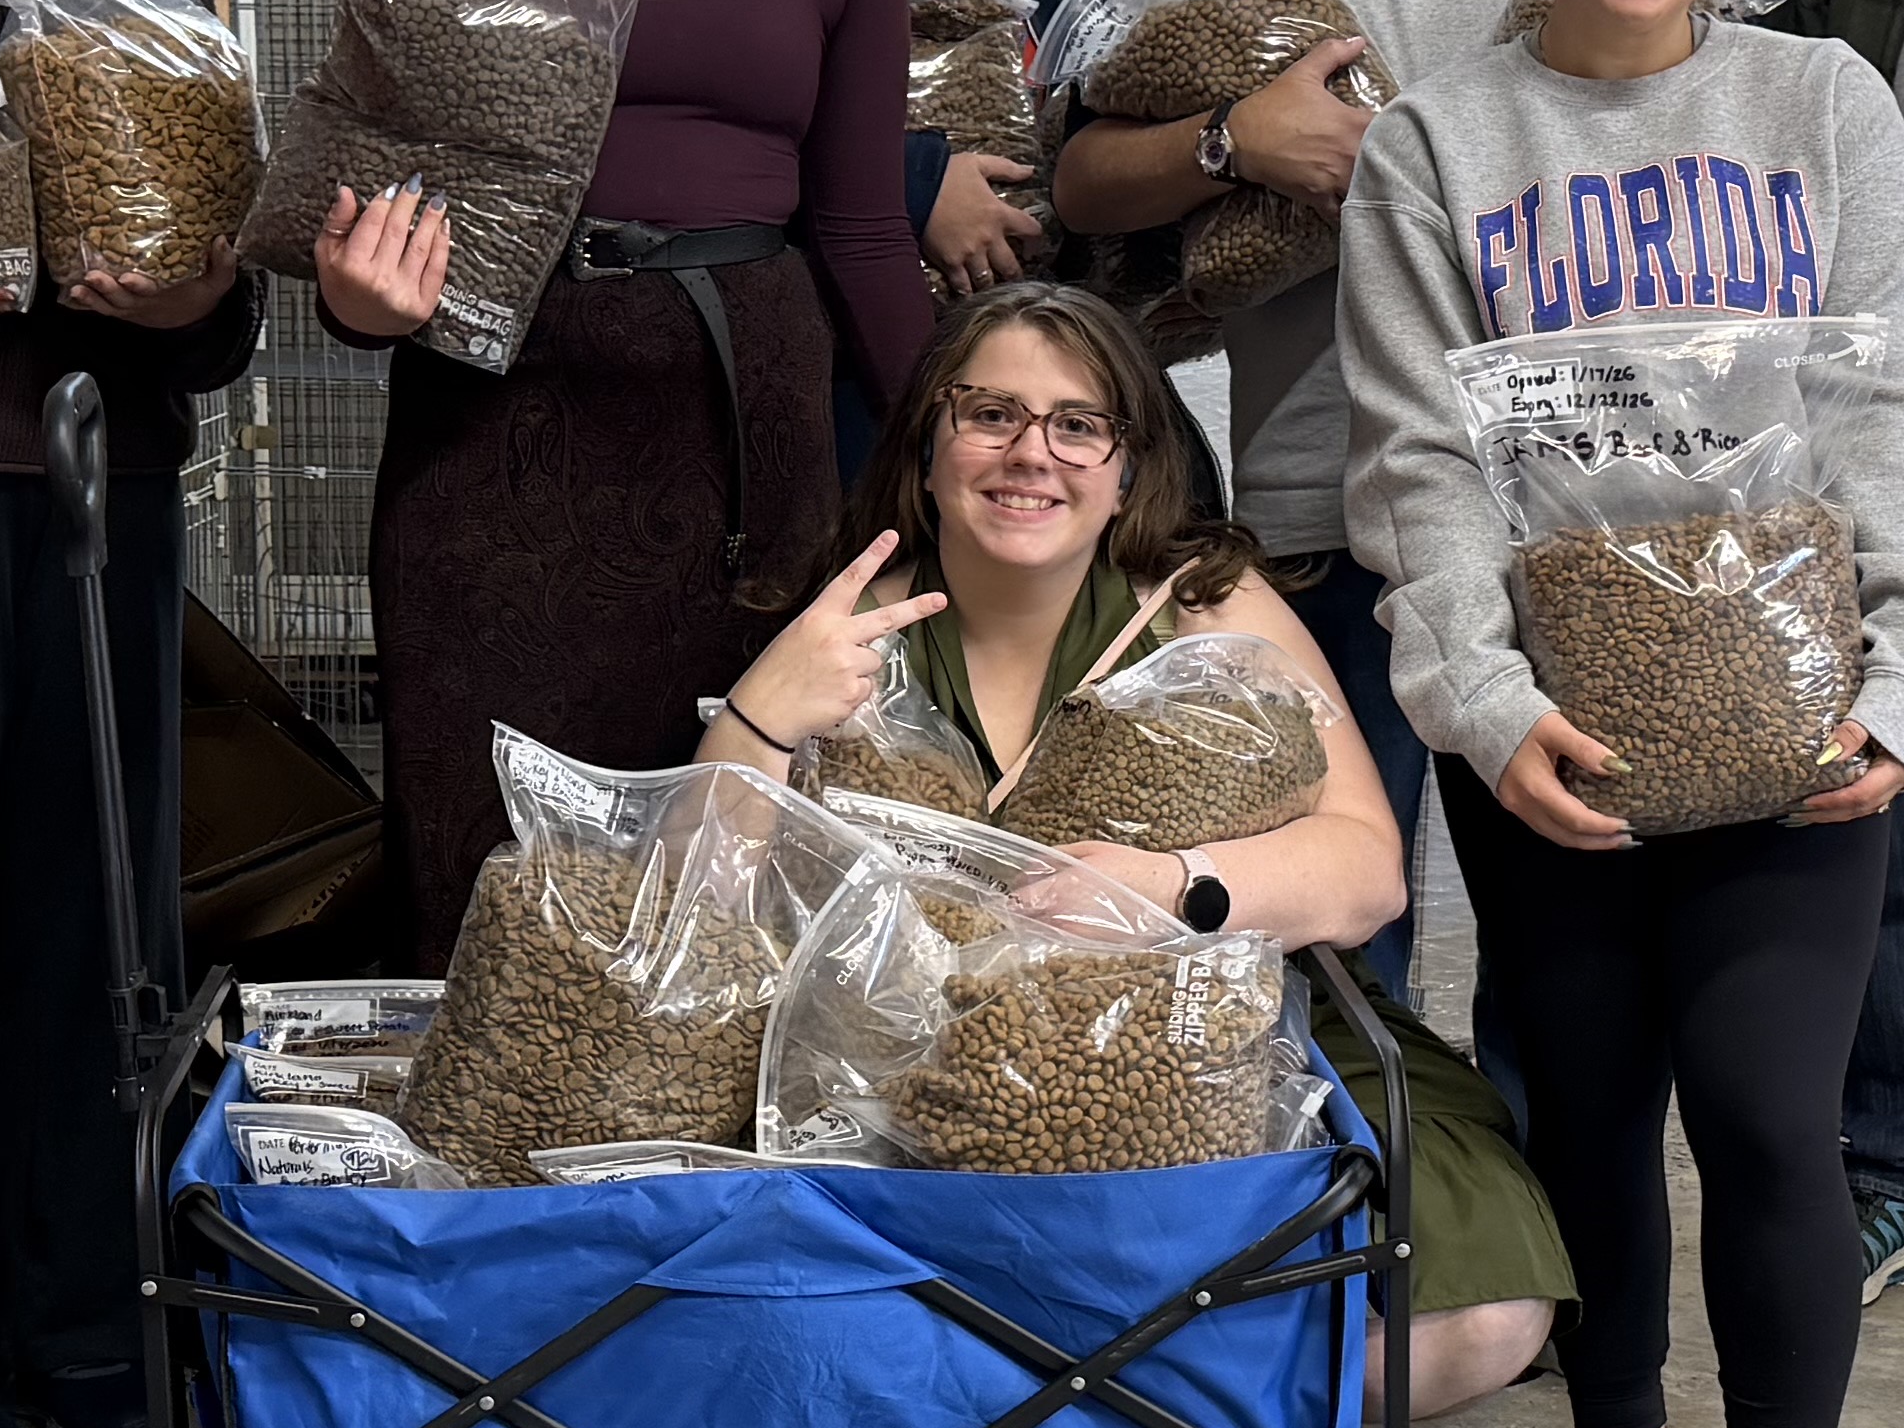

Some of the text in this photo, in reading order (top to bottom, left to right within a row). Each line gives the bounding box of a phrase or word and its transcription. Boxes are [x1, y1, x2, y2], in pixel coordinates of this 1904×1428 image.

[1473, 153, 1821, 340] FLORIDA
[4, 259, 32, 276] BAG
[1774, 352, 1826, 369] CLOSED
[1572, 365, 1636, 384] 1/17/26
[1167, 990, 1188, 1045] SLIDING
[1183, 980, 1211, 1047] ZIPPER
[258, 1138, 285, 1150] DATE
